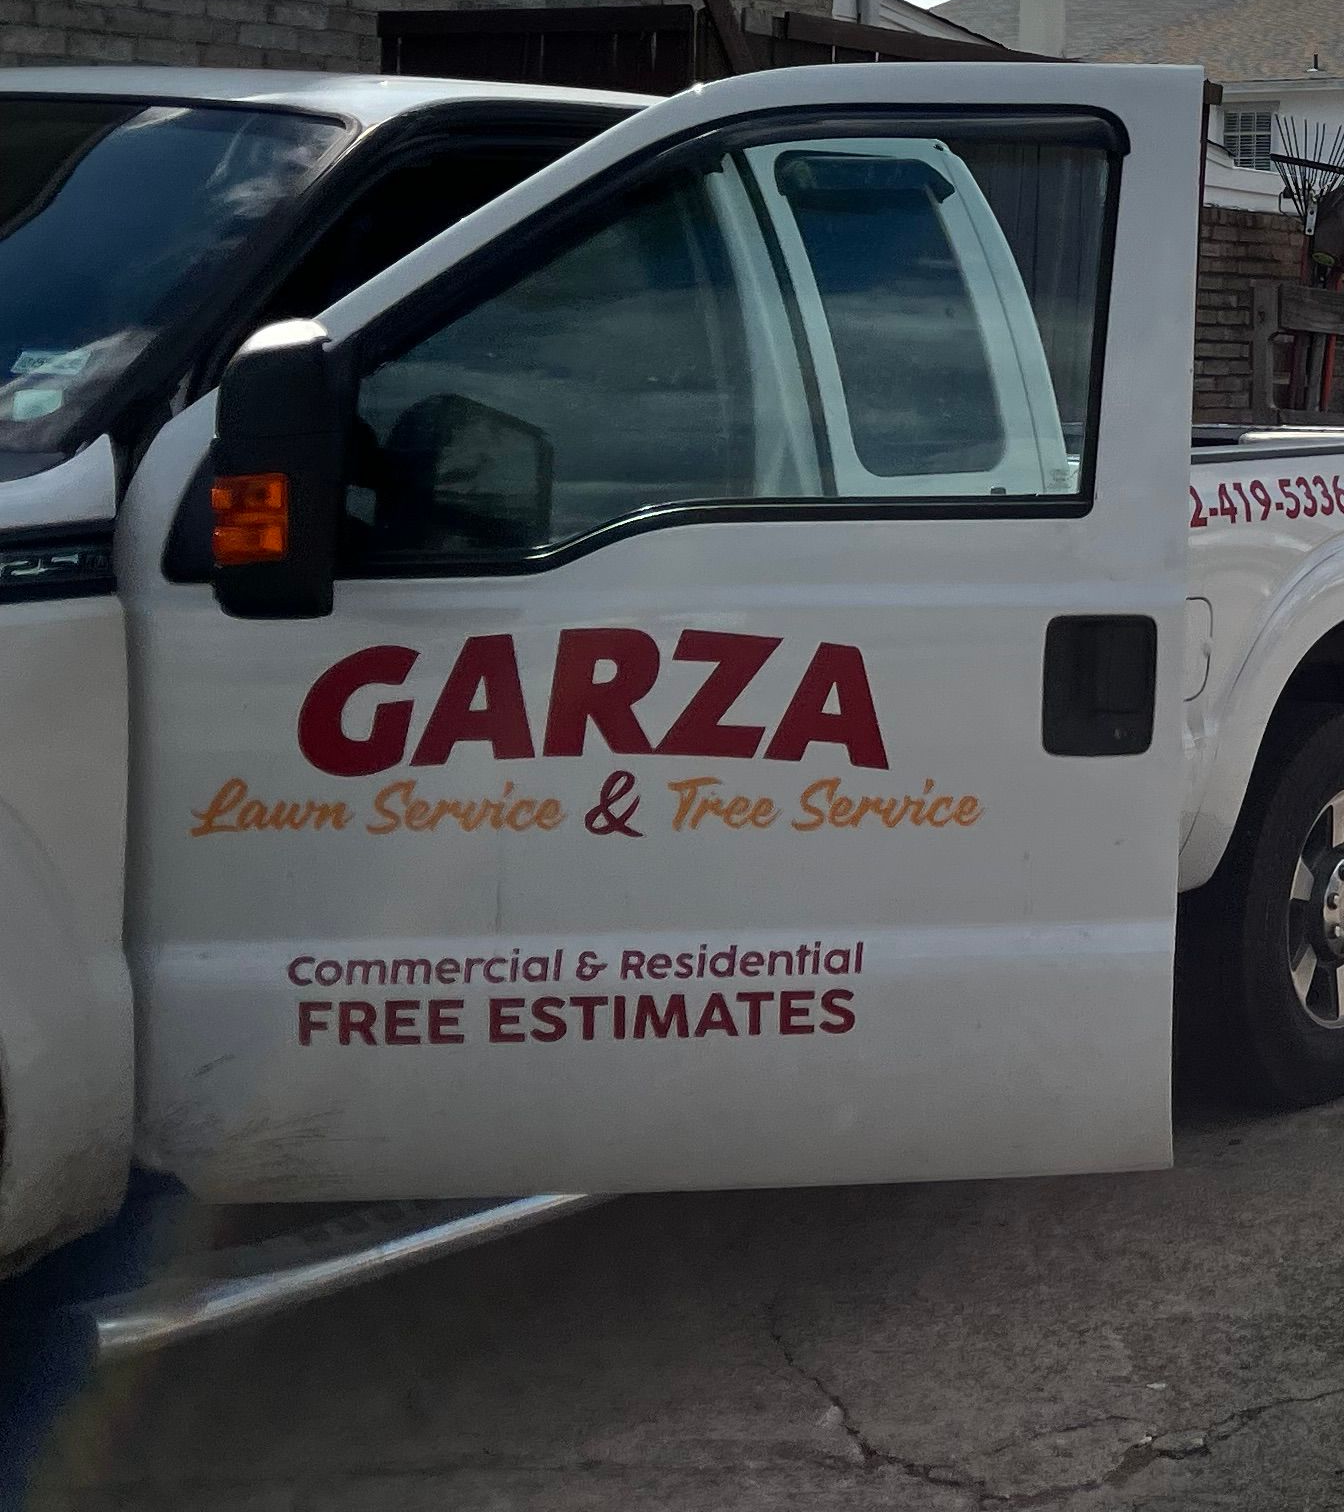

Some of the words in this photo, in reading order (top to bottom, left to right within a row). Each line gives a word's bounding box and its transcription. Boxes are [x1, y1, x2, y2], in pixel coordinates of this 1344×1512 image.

[297, 627, 889, 777] GARZA
[190, 777, 354, 837] Lawn
[366, 779, 565, 835] Service
[584, 770, 644, 838] &
[667, 776, 780, 831] Tree
[791, 776, 983, 831] Service
[287, 947, 564, 987] Commercial
[575, 950, 608, 982] &
[619, 940, 864, 981] Residential
[298, 999, 465, 1047] FREE
[488, 988, 856, 1043] ESTIMATES
